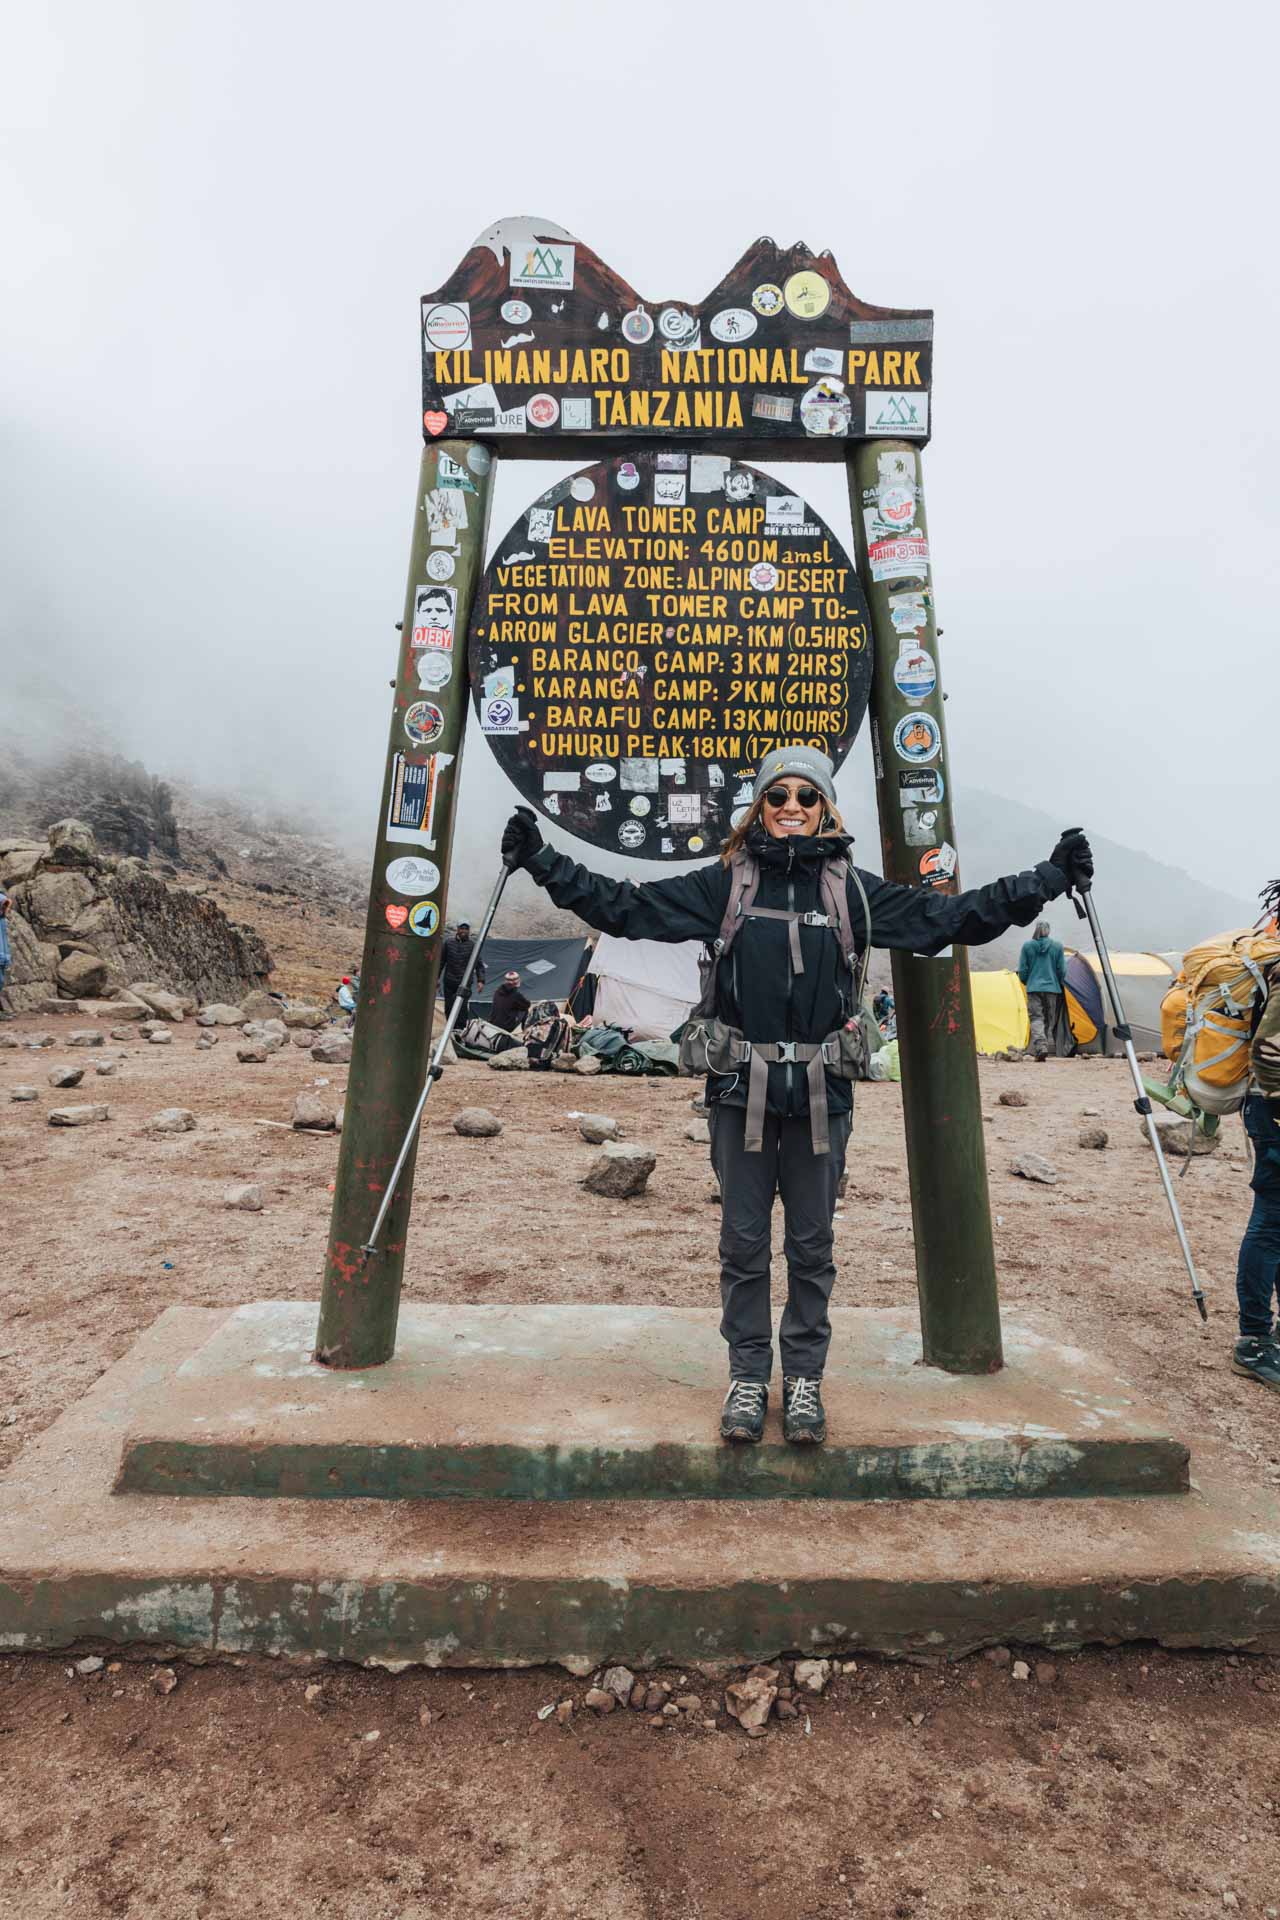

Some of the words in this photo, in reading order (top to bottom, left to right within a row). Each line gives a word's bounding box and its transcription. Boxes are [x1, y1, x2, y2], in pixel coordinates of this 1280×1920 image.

[435, 348, 630, 384] KILIMANJARO
[661, 348, 809, 384] NATIONAL
[848, 350, 921, 385] PARK
[594, 390, 743, 428] TANZANIA
[557, 506, 611, 532] LAVA
[622, 506, 696, 534] TOWER
[707, 508, 764, 534] CAMP
[549, 538, 689, 560] ELEVATION:
[700, 540, 777, 562] 4600M
[782, 540, 831, 564] amsl
[497, 565, 610, 588] VEGETATION
[624, 566, 682, 589] ZONE:
[687, 567, 752, 591] ALPINE
[774, 569, 847, 593] DESERT
[488, 593, 558, 615] FROM
[569, 593, 628, 616] LAVA
[646, 595, 728, 618] TOWER
[740, 597, 804, 619] CAMP
[489, 621, 556, 643] ARROW
[569, 622, 663, 645] GLACIER
[677, 624, 743, 645] CAMP:
[788, 622, 867, 653] (0.5HRS)
[532, 648, 638, 672] BARANCO
[655, 651, 724, 673] CAMP:
[534, 677, 639, 700] KARANGA
[654, 679, 718, 701] CAMP:
[727, 680, 775, 703] 9KM
[779, 677, 849, 709] (6HRS)
[547, 706, 640, 728] BARAFU
[653, 707, 716, 729] CAMP:
[723, 709, 778, 731] 13KM
[780, 709, 849, 737] (10HRS)
[542, 733, 619, 757] UHURU
